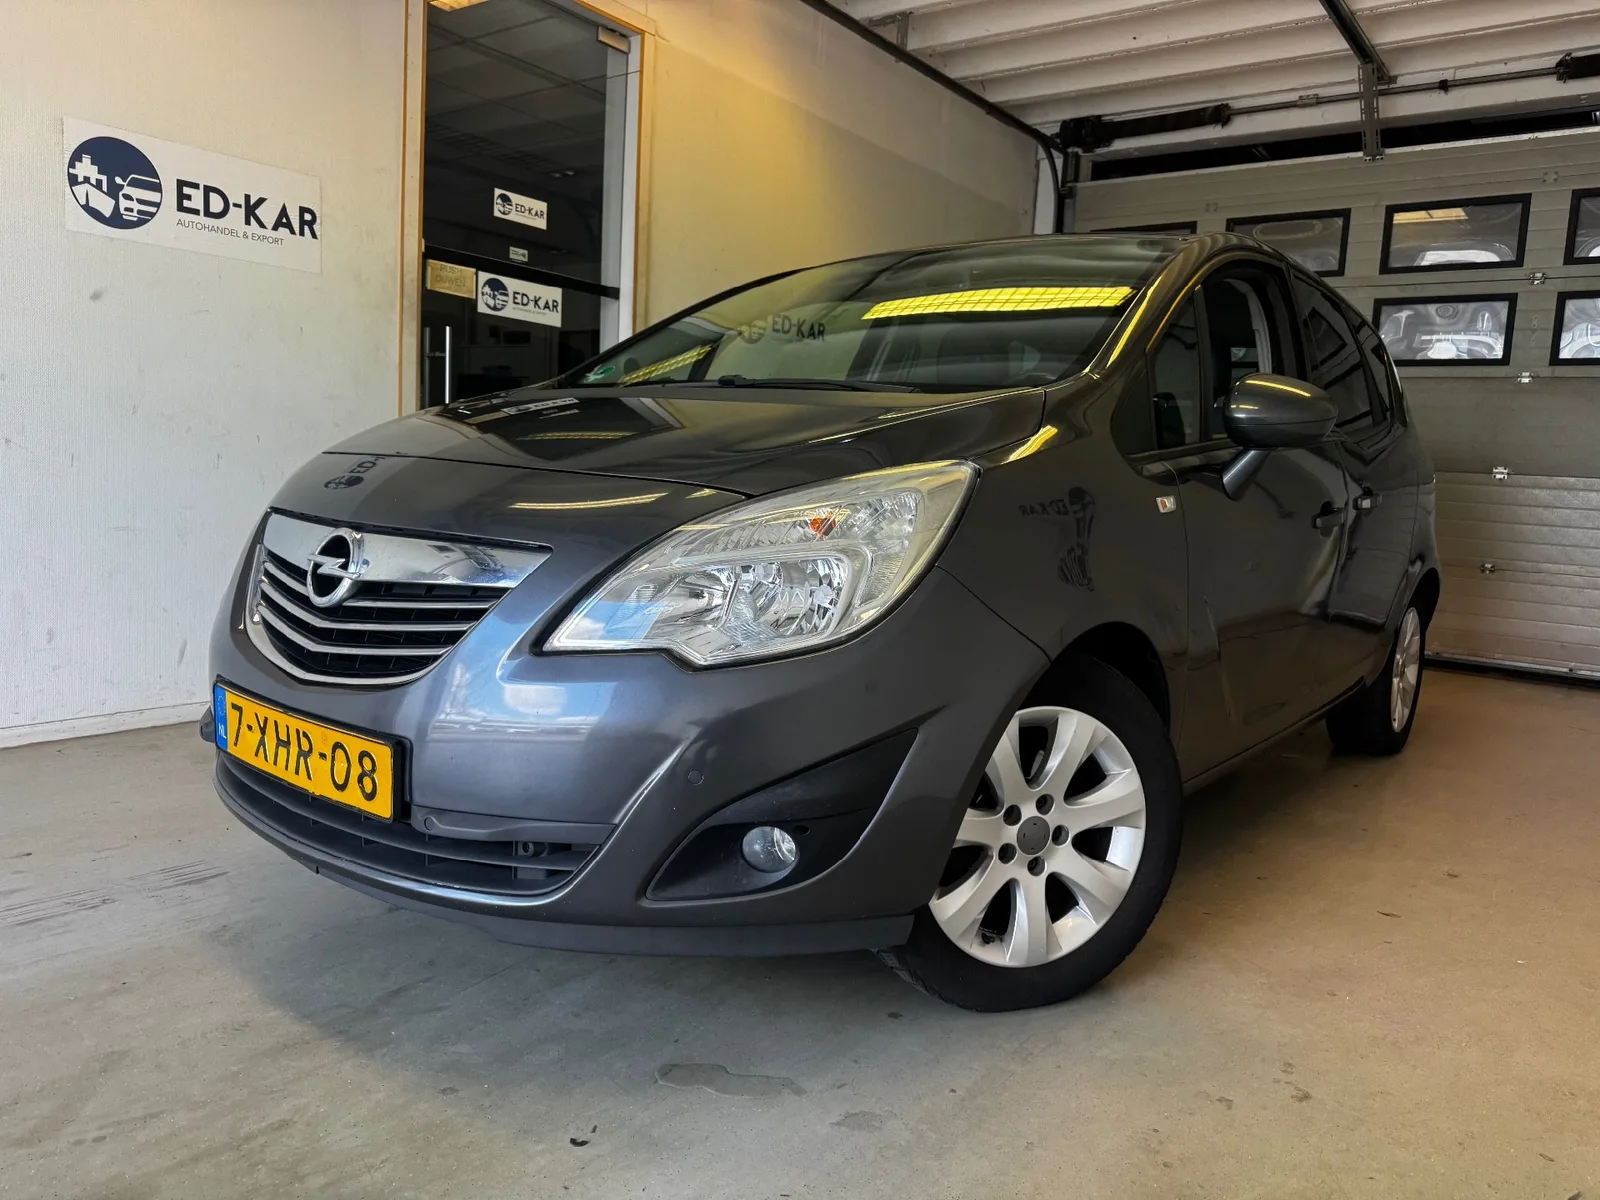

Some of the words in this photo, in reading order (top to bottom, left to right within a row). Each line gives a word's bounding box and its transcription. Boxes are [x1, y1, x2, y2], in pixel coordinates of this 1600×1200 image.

[176, 178, 318, 240] ED-KAR
[515, 203, 545, 220] ED-KAR
[176, 219, 241, 239] AUTOHANDEL
[242, 231, 249, 239] &
[251, 232, 284, 246] EXPORT
[512, 291, 559, 313] ED-KAR
[771, 314, 826, 341] ED-KAR
[218, 722, 227, 739] NL
[230, 702, 378, 802] 7-XHR-08
